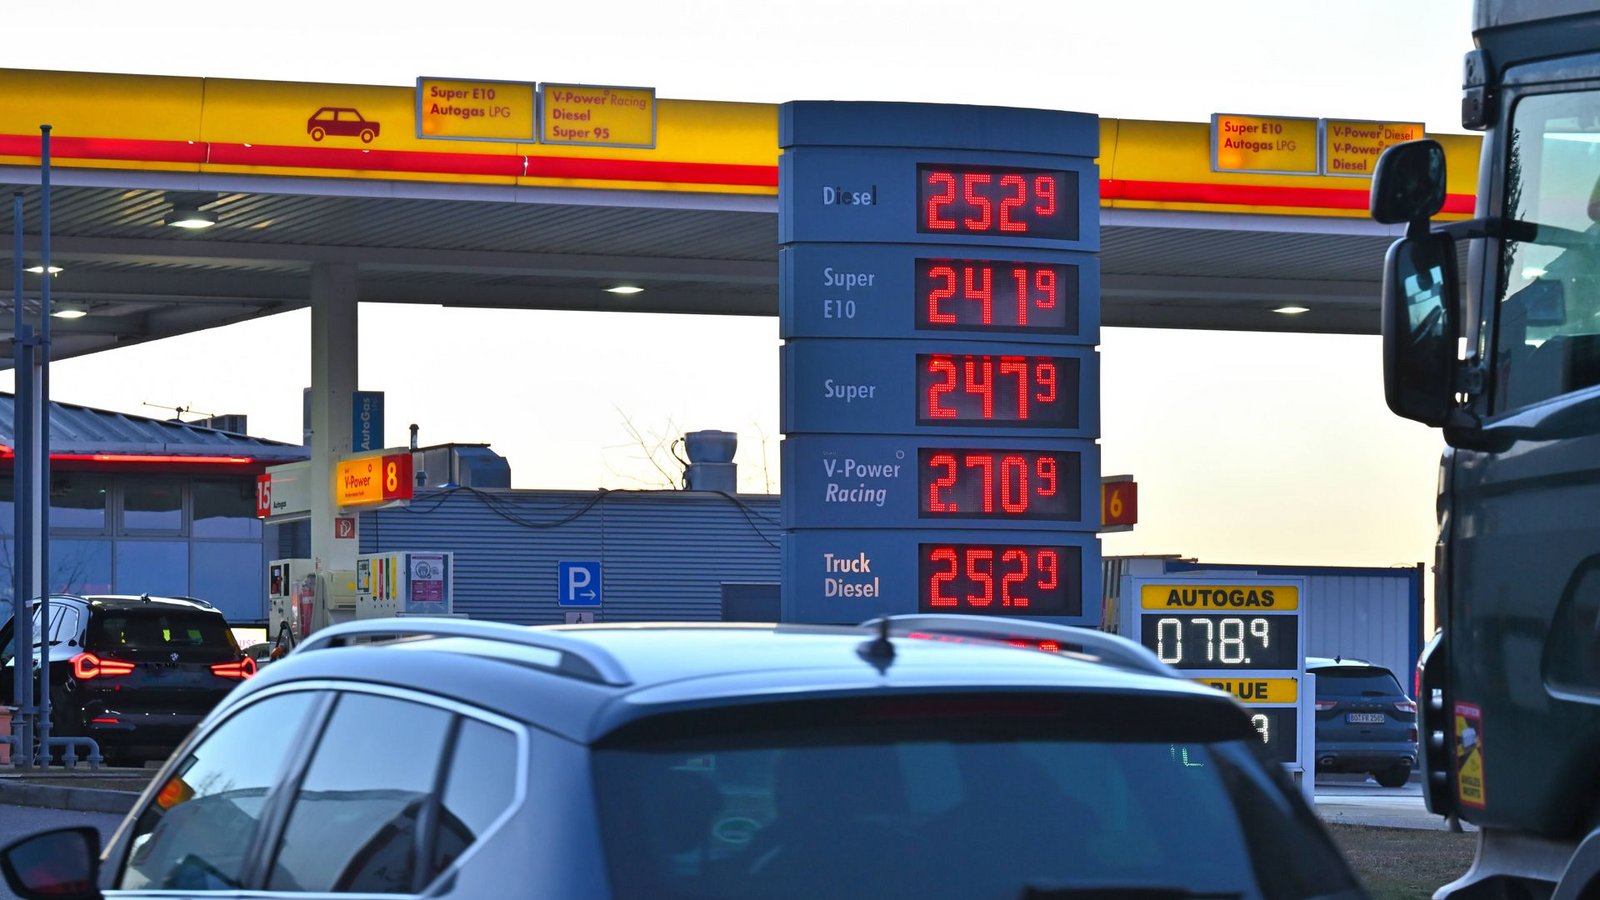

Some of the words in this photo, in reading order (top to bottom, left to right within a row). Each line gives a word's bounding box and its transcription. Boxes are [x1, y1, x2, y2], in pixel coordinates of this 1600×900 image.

[430, 86, 469, 101] Super
[472, 88, 496, 100] E10
[553, 91, 606, 105] V-Power
[610, 95, 647, 109] Racing
[430, 104, 485, 119] Autogas
[489, 106, 511, 118] LPG
[552, 109, 591, 121] Diesel
[552, 126, 590, 140] Super
[594, 127, 610, 139] 95
[1224, 121, 1258, 135] Super
[1262, 123, 1282, 135] E10
[1333, 126, 1381, 139] V-Power
[1384, 128, 1414, 141] Diesel
[1224, 138, 1273, 152] Autogas
[1276, 141, 1297, 151] LPG
[1333, 142, 1381, 155] V-Power
[1333, 158, 1367, 171] Diesel
[823, 185, 877, 206] Diesel
[823, 267, 875, 292] Super
[823, 300, 856, 319] E10
[824, 378, 876, 403] Super
[360, 397, 371, 450] AutoGas
[344, 475, 370, 489] V-Power
[386, 462, 398, 493] 8
[823, 458, 901, 479] V-Power
[257, 480, 271, 510] 15
[273, 499, 287, 510] Autogas
[825, 483, 887, 507] Racing
[1110, 488, 1123, 518] 6
[824, 552, 871, 573] Truck
[568, 566, 592, 601] P
[824, 576, 880, 598] Diesel
[1167, 589, 1275, 607] AUTOGAS
